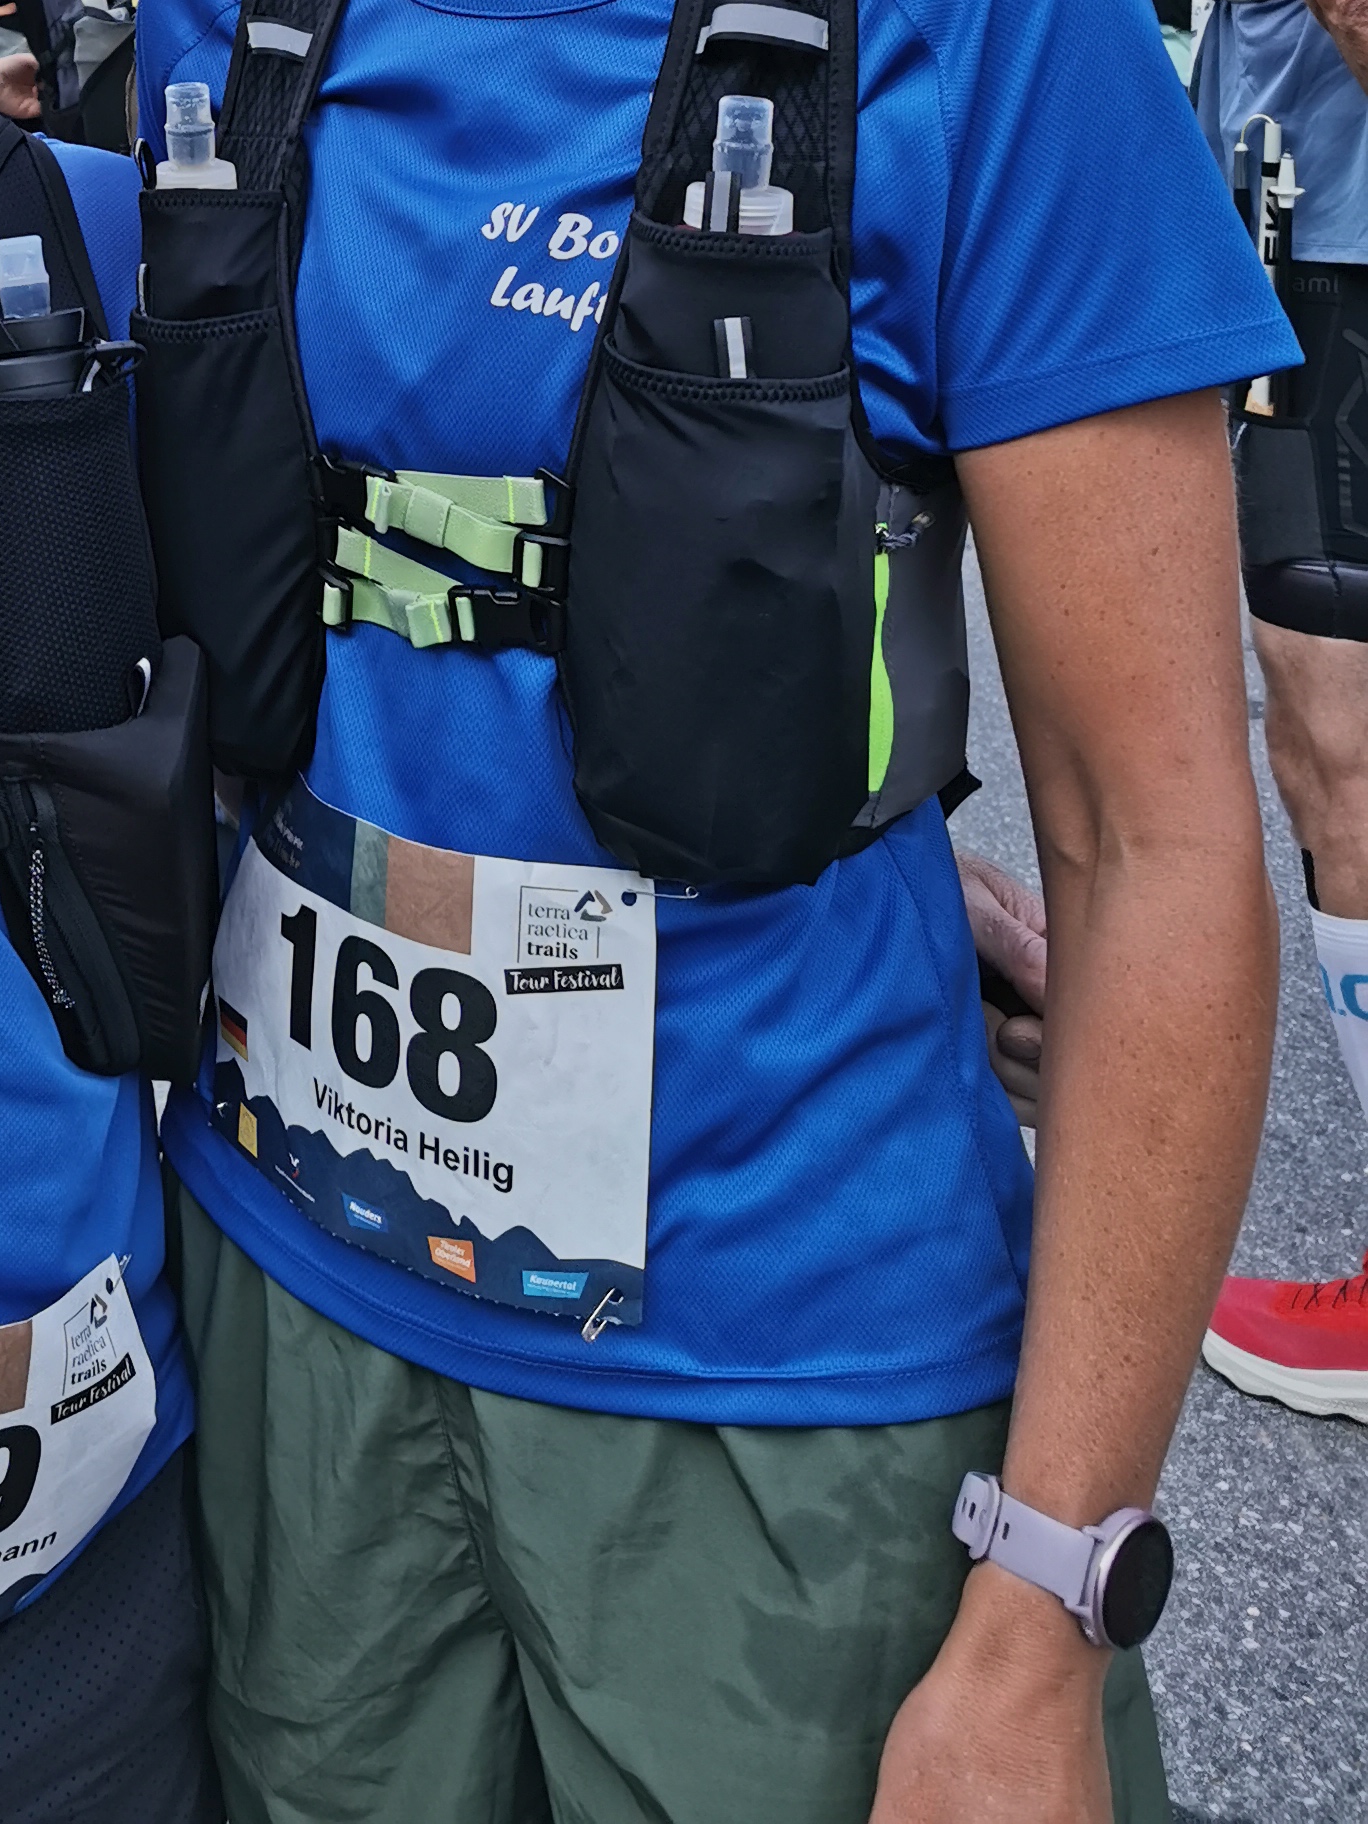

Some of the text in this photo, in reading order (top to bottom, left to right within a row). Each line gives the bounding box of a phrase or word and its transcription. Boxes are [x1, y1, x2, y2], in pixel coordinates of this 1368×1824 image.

[481, 202, 619, 260] SV Bo
[527, 903, 571, 921] terra
[527, 941, 579, 960] trails
[509, 966, 621, 991] Tour Festival
[281, 903, 498, 1123] 168
[313, 1076, 409, 1154] Viktoria
[419, 1131, 514, 1194] Heilig
[71, 1324, 92, 1350] terra
[71, 1358, 108, 1385] trails
[55, 1357, 133, 1420] Tour Festival
